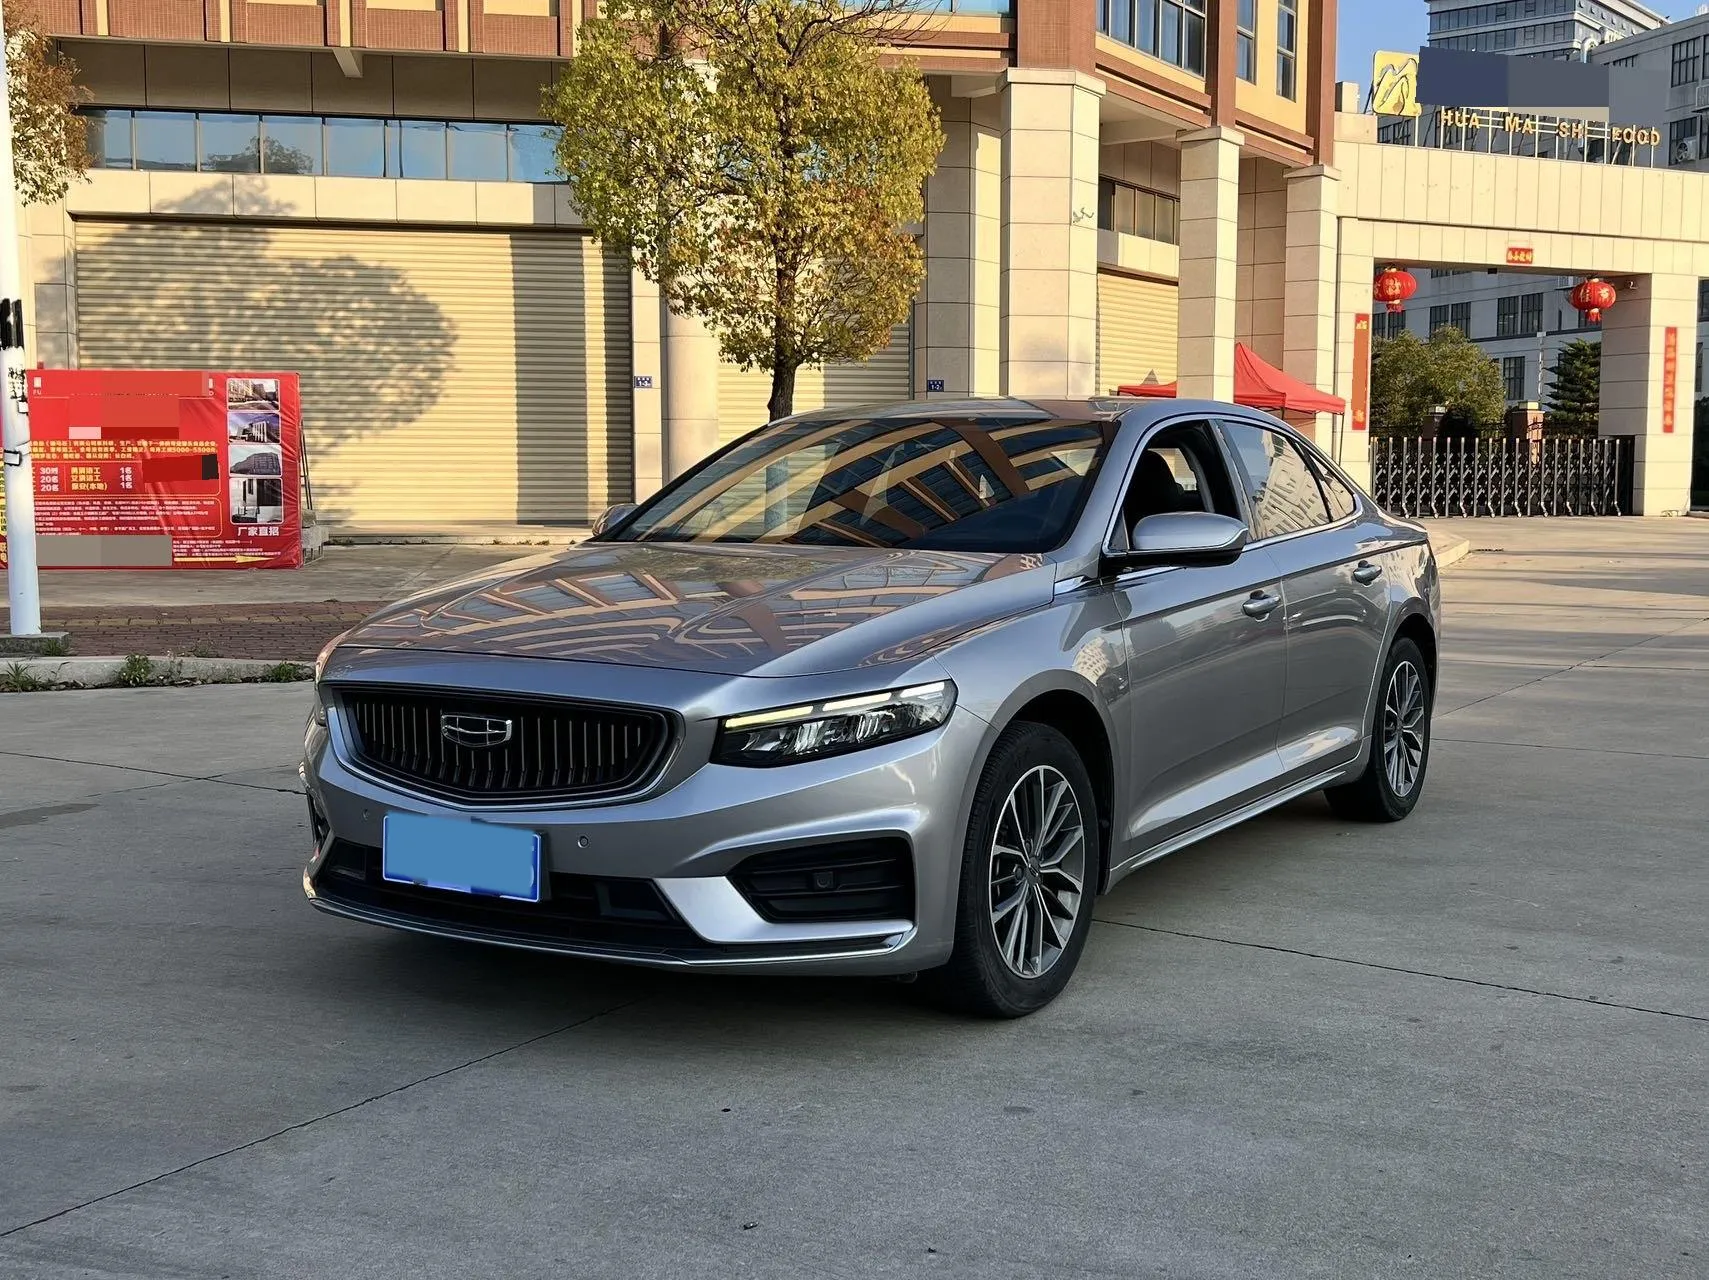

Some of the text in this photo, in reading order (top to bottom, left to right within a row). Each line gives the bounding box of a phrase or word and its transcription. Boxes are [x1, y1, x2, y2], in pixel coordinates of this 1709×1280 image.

[1440, 109, 1480, 129] HUA
[1505, 115, 1533, 134] MA
[1612, 126, 1660, 146] FOOD
[237, 526, 280, 537] 厂家直招
